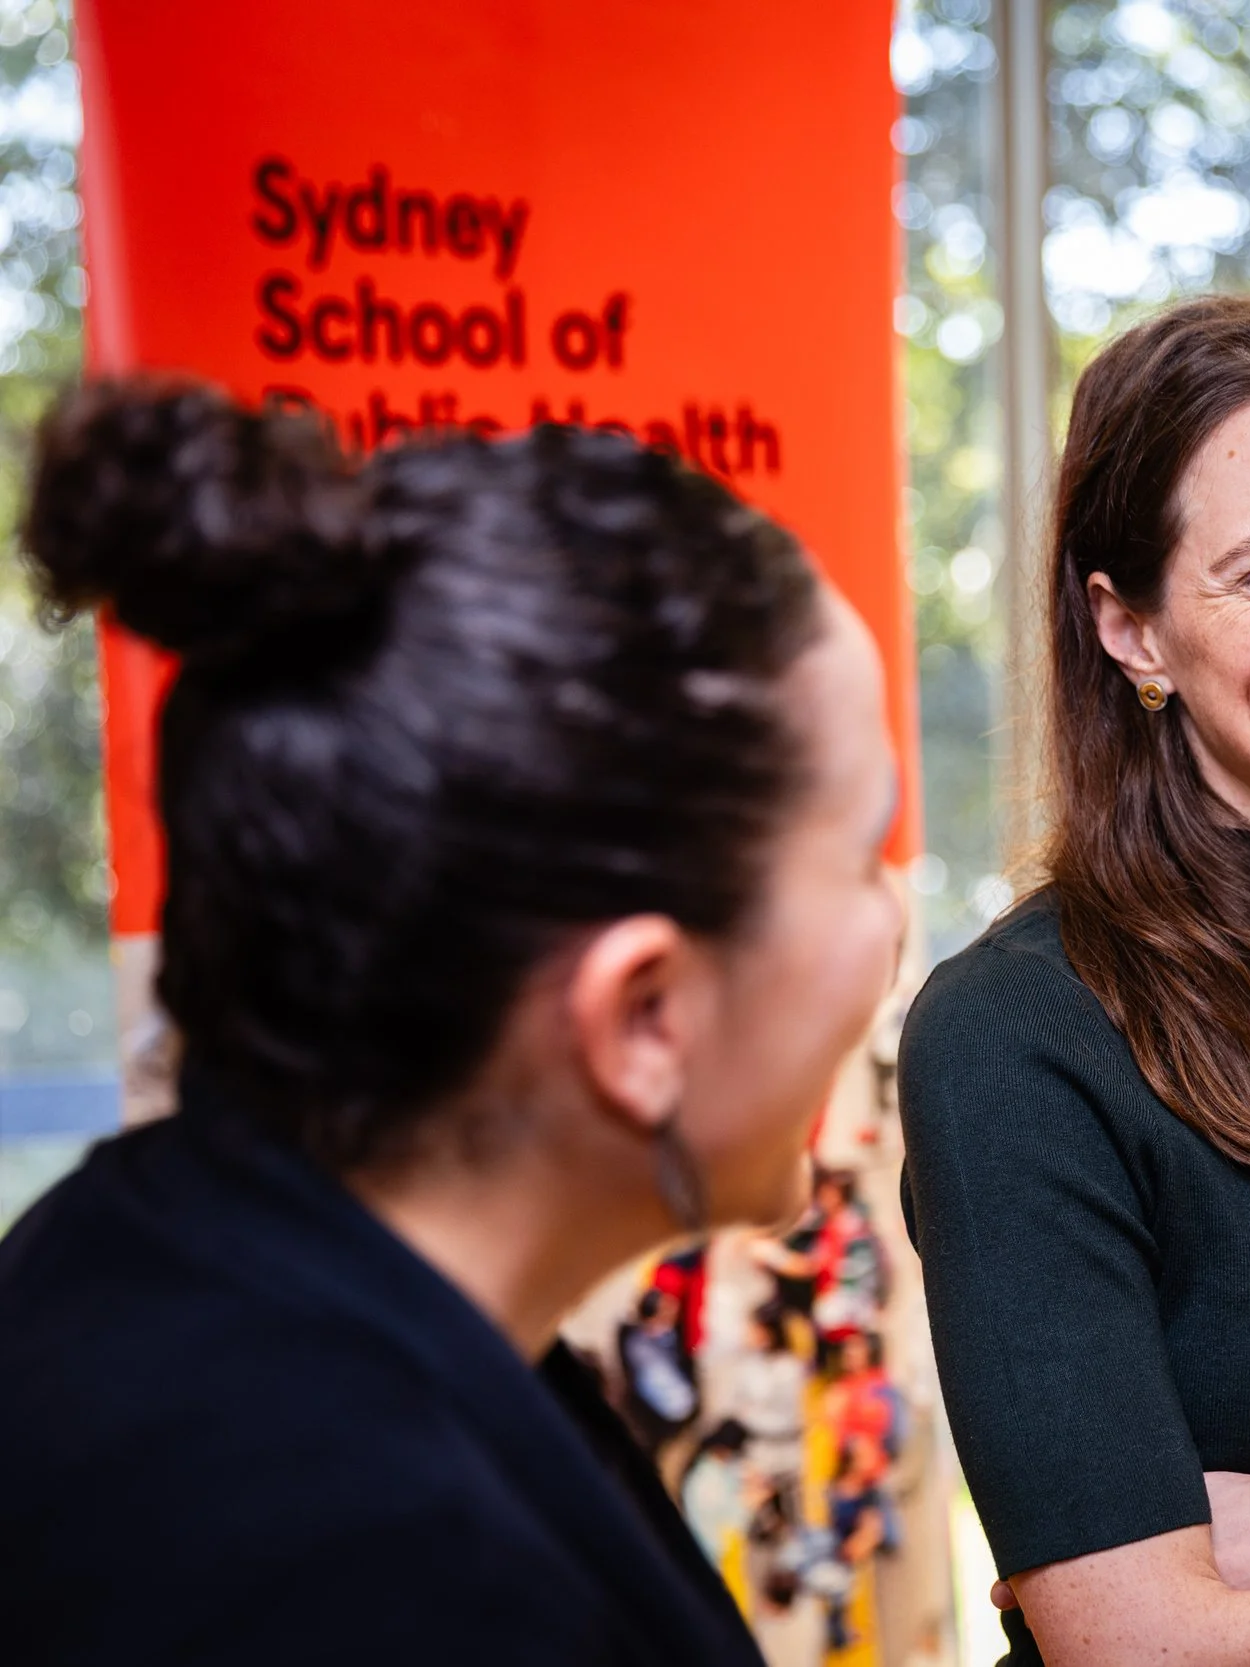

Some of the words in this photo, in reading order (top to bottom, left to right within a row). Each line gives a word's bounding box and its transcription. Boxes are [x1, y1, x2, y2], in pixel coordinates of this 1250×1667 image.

[254, 157, 529, 281] Sydney
[256, 271, 527, 368] School
[550, 290, 633, 371] of
